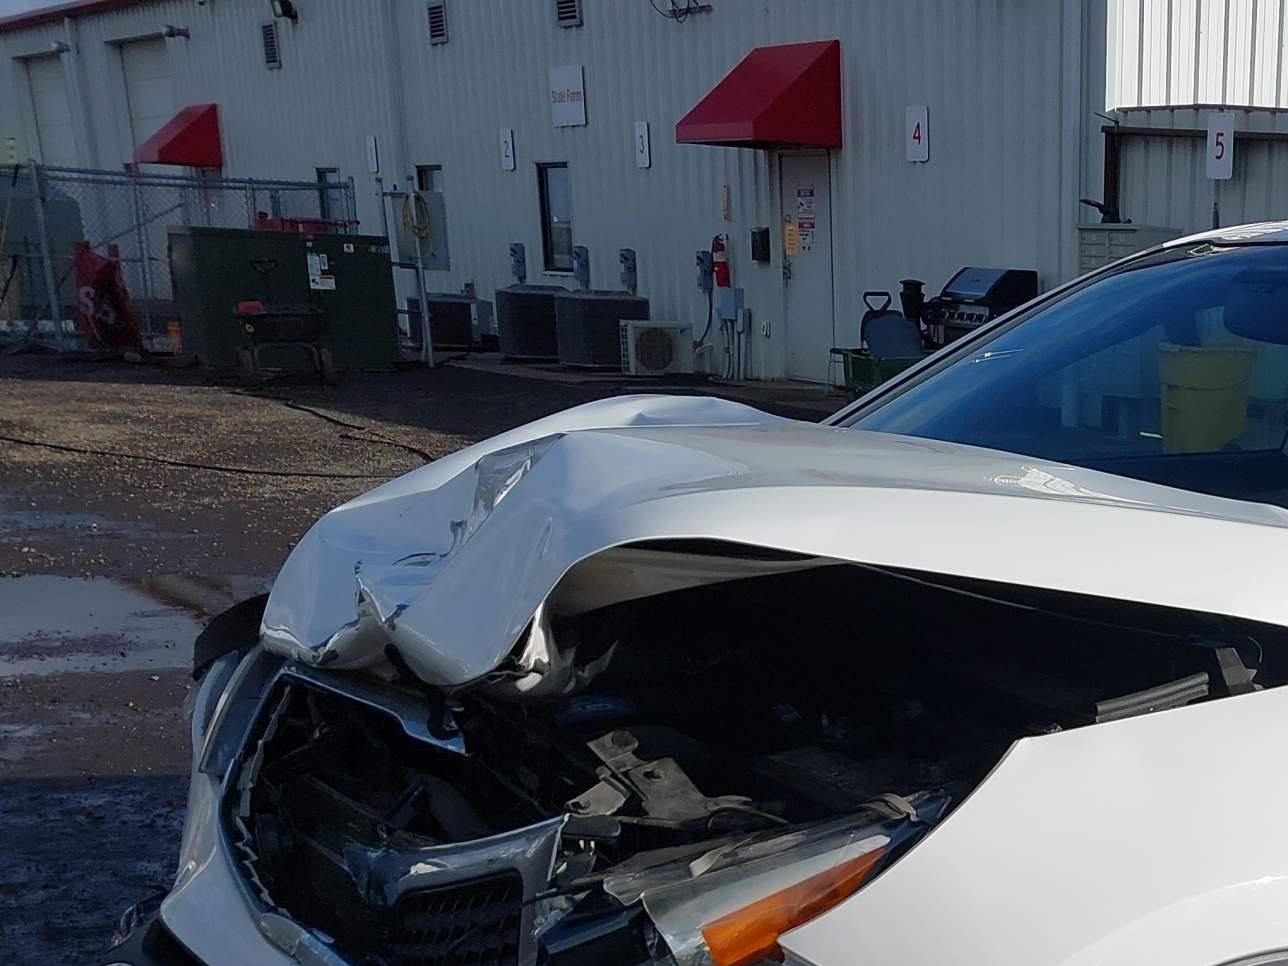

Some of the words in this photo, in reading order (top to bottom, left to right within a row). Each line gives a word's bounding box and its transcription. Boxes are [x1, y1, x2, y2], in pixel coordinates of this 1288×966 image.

[639, 134, 645, 154] 3
[912, 122, 922, 146] 4
[503, 139, 510, 158] 2
[1215, 132, 1225, 160] 5
